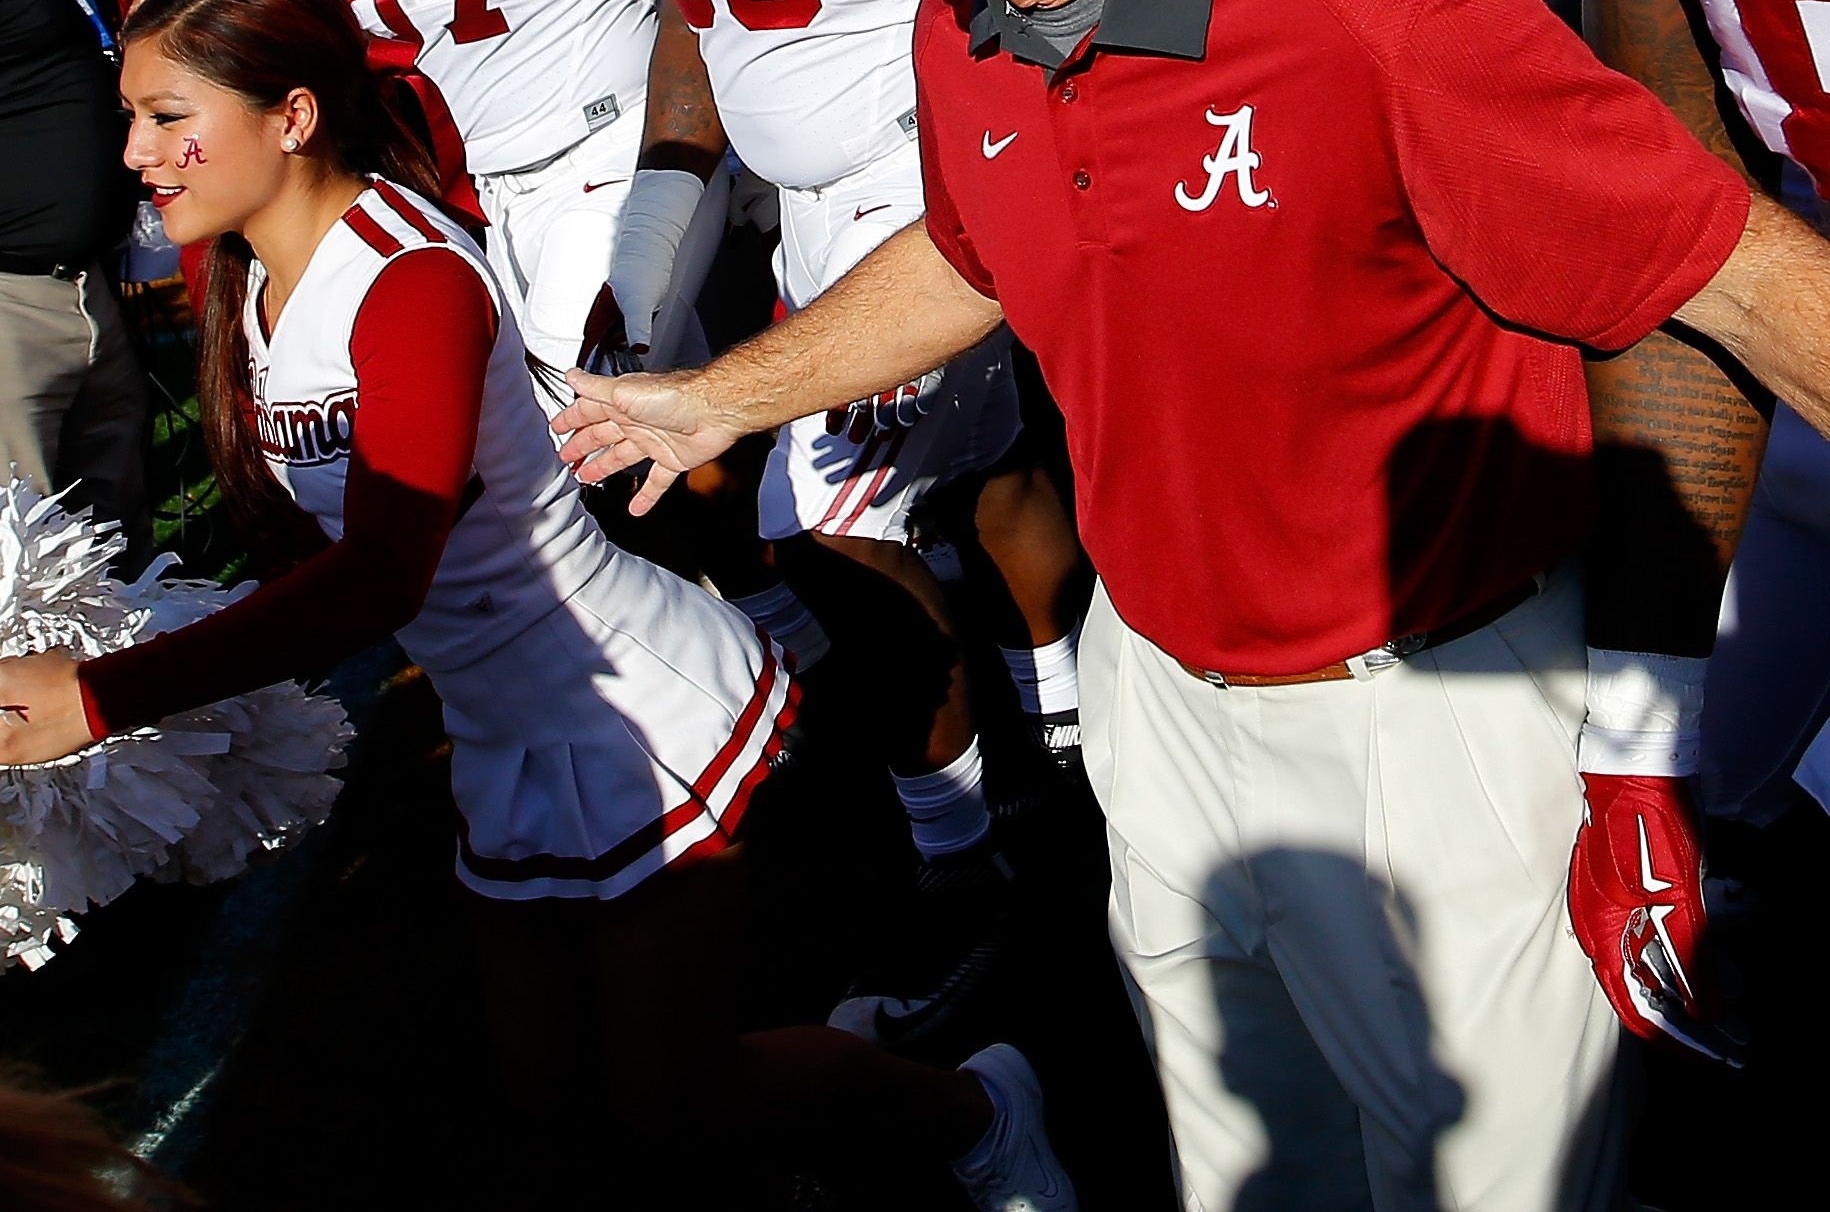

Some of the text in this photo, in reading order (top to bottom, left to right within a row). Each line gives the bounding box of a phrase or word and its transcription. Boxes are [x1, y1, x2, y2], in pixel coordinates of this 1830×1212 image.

[591, 102, 607, 116] 44
[175, 137, 208, 169] A
[1174, 103, 1270, 212] A
